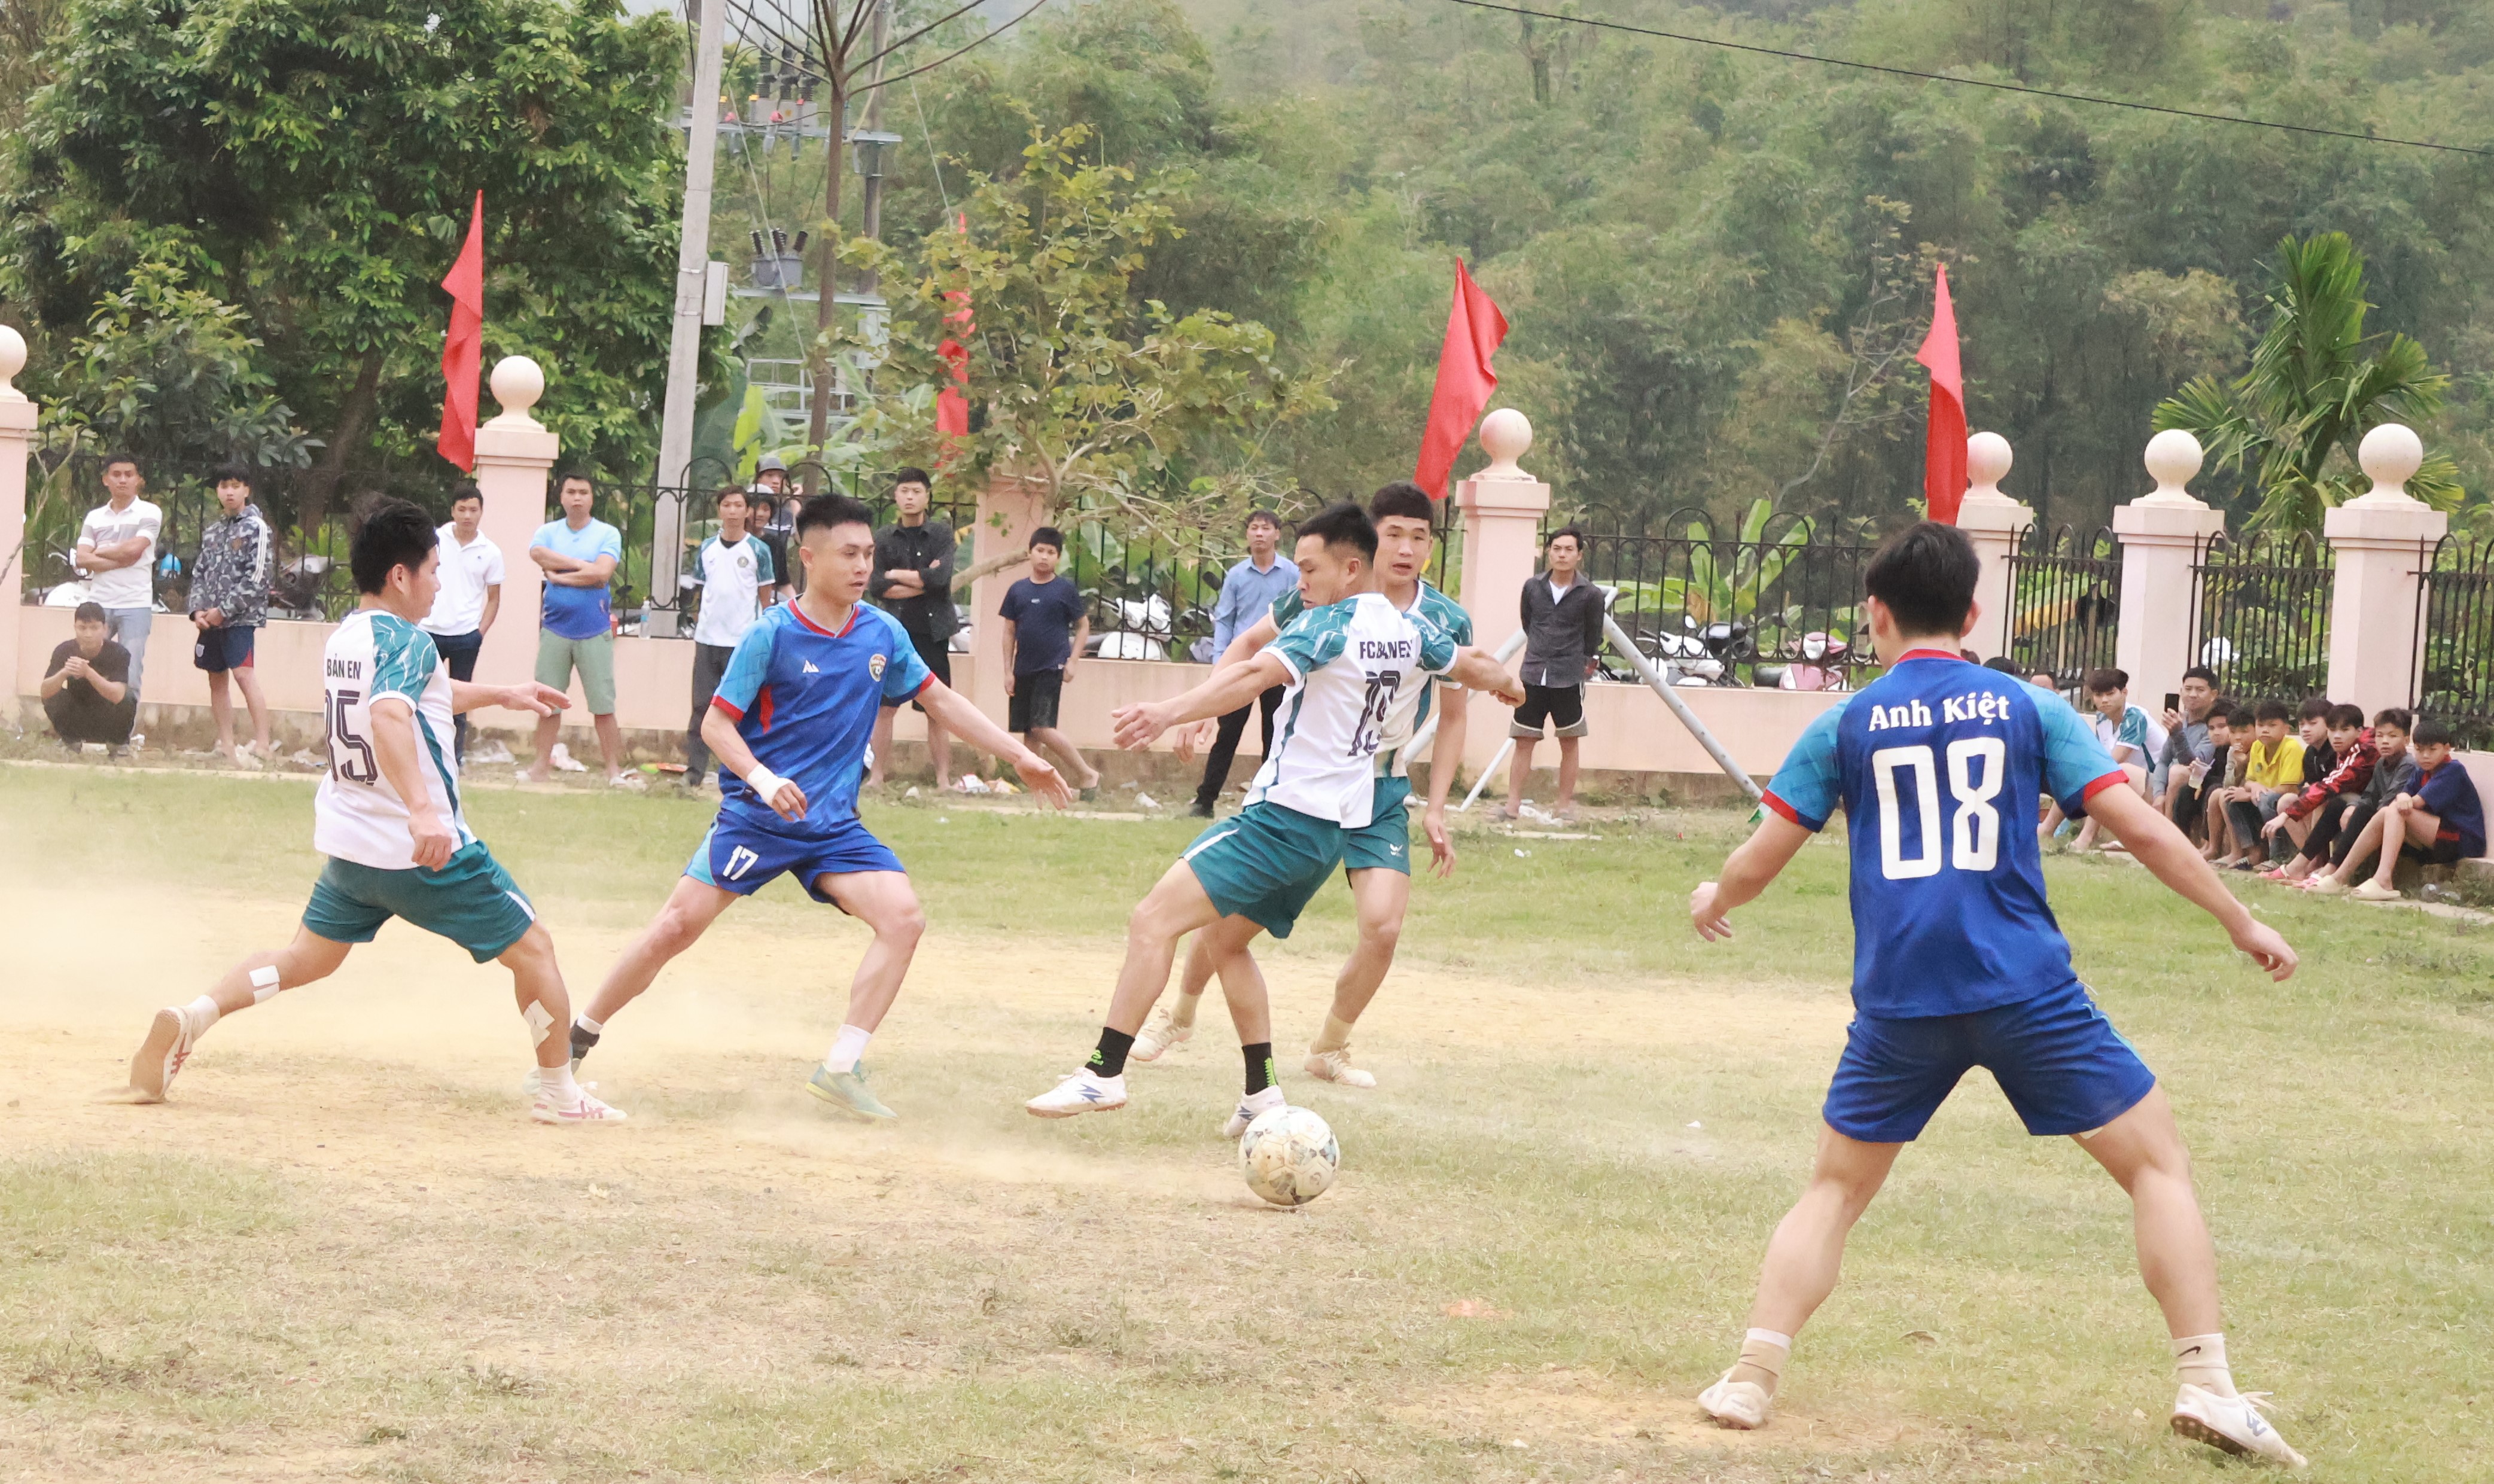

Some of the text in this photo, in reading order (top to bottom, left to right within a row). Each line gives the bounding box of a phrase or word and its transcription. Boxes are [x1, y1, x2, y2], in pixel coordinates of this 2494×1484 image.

[348, 660, 361, 680] EN
[1869, 691, 2010, 732] Anh Kiệt
[1872, 736, 2005, 880] 08
[723, 845, 759, 881] 17
